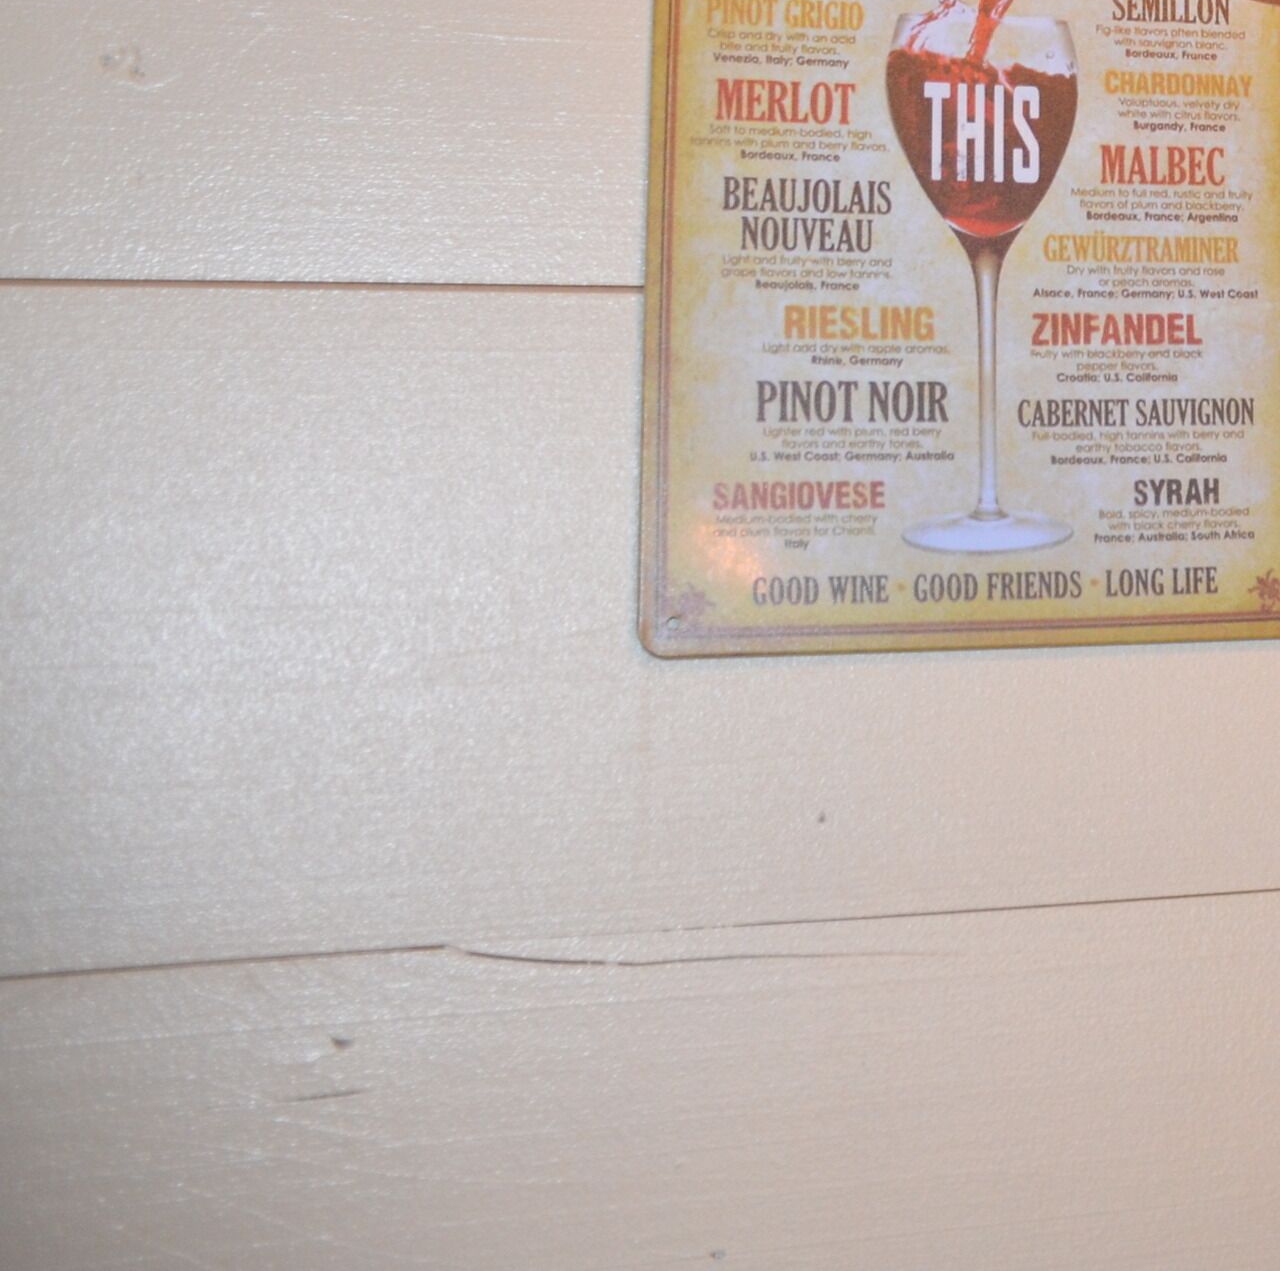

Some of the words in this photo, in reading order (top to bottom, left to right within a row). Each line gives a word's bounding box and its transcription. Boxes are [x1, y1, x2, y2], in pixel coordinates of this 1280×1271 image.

[796, 56, 849, 69] Germany
[1104, 70, 1253, 98] CHARDONNAY
[716, 78, 856, 126] MERLOT
[924, 82, 1040, 183] THIS
[1190, 122, 1226, 132] France
[1099, 144, 1225, 186] MALBEC
[722, 176, 892, 216] BEAUJOLAIS
[1187, 213, 1238, 223] Argentina
[740, 216, 874, 253] NOUVEAU
[1043, 231, 1240, 264] GEWÜRZTRAMINER
[1200, 290, 1225, 299] West
[1228, 290, 1258, 299] Coast
[784, 304, 935, 341] RIESLING
[1031, 312, 1203, 346] ZINFANDEL
[756, 380, 858, 423] PINOT
[868, 381, 949, 424] NOIR
[1018, 398, 1130, 428] CABERNET
[1136, 398, 1254, 426] SAUVIGNON
[712, 481, 886, 510] SANGIOVESE
[1134, 478, 1220, 506] SYRAH
[784, 539, 810, 551] Italy
[1191, 531, 1222, 540] South
[1224, 530, 1255, 540] Africa
[752, 576, 819, 606] GOOD
[829, 575, 889, 604] WINE
[913, 572, 978, 603] GOOD
[987, 571, 1082, 601] FRIENDS
[1105, 568, 1165, 597] LONG
[1172, 566, 1219, 595] LIFE
